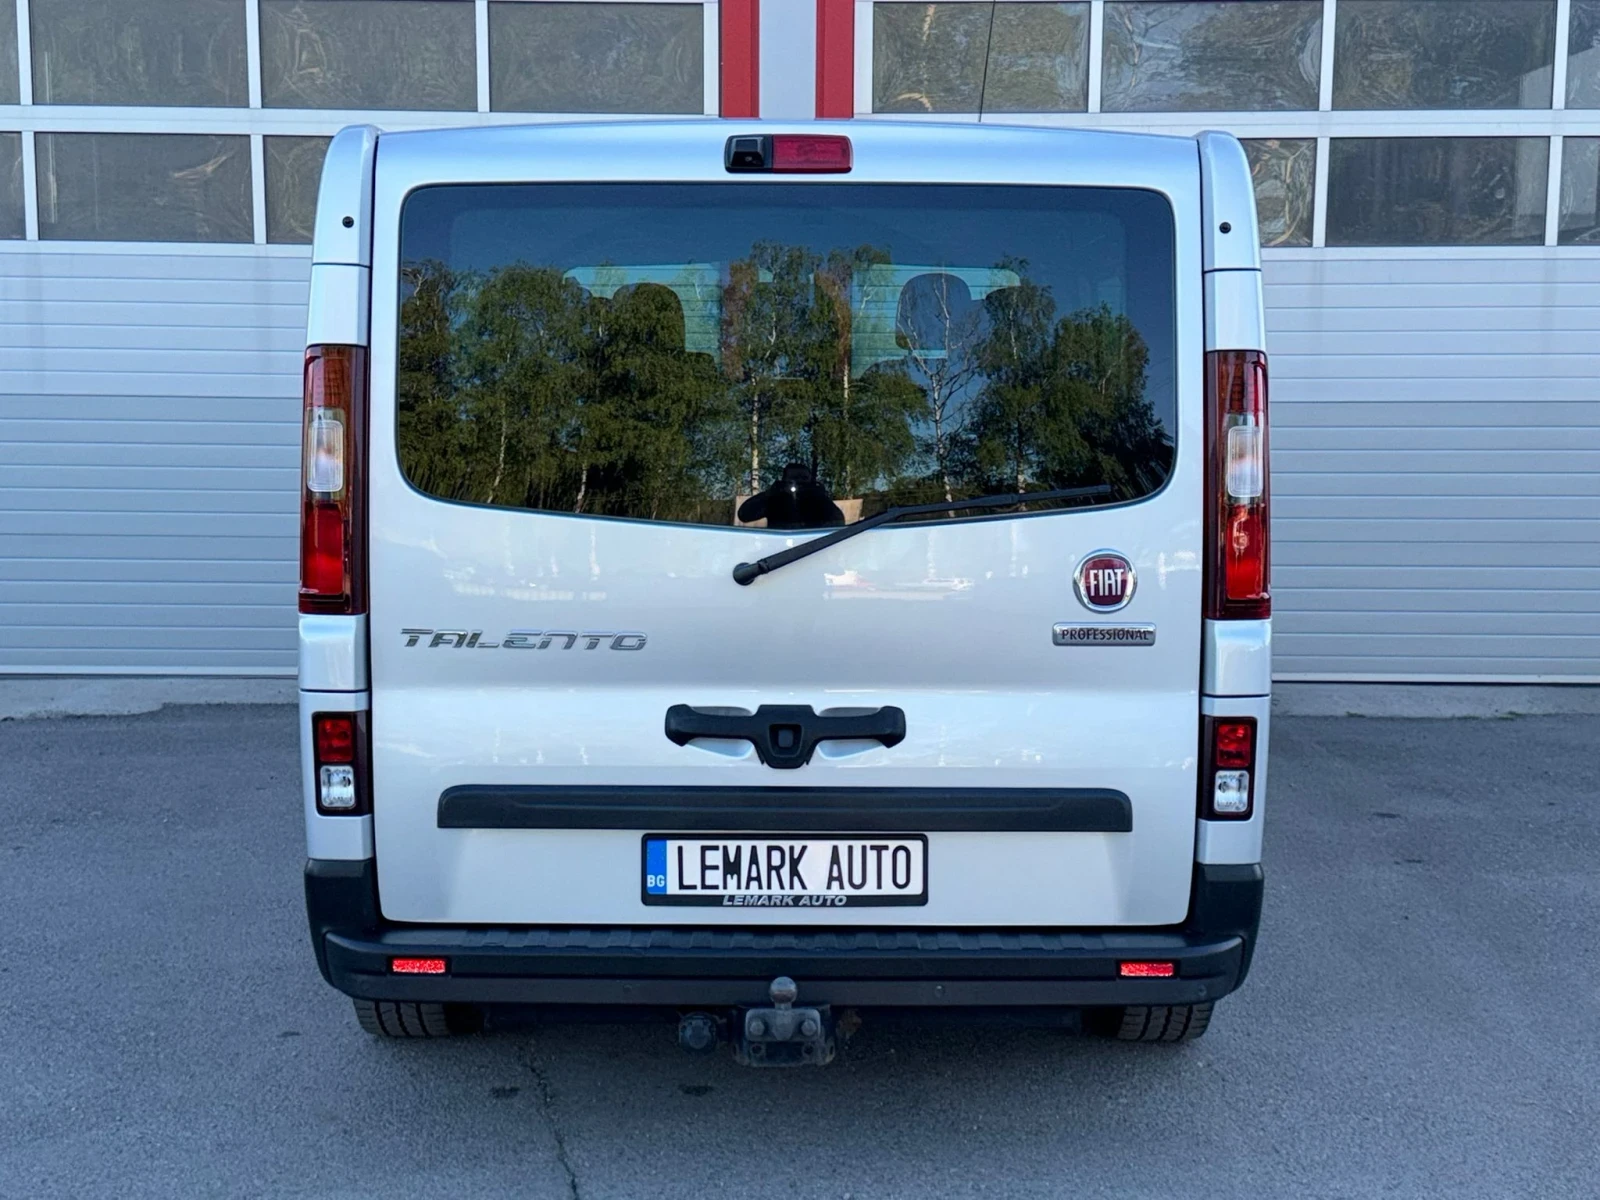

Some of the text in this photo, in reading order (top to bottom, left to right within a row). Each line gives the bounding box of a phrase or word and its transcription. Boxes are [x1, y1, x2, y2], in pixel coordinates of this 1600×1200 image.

[1089, 569, 1124, 596] FIAT
[400, 628, 648, 651] TALENTO
[1062, 628, 1149, 640] PROFESSIONAL
[677, 845, 911, 890] LEMARK AUTO
[647, 875, 665, 887] BG
[722, 895, 847, 906] LEMARK AUTO
